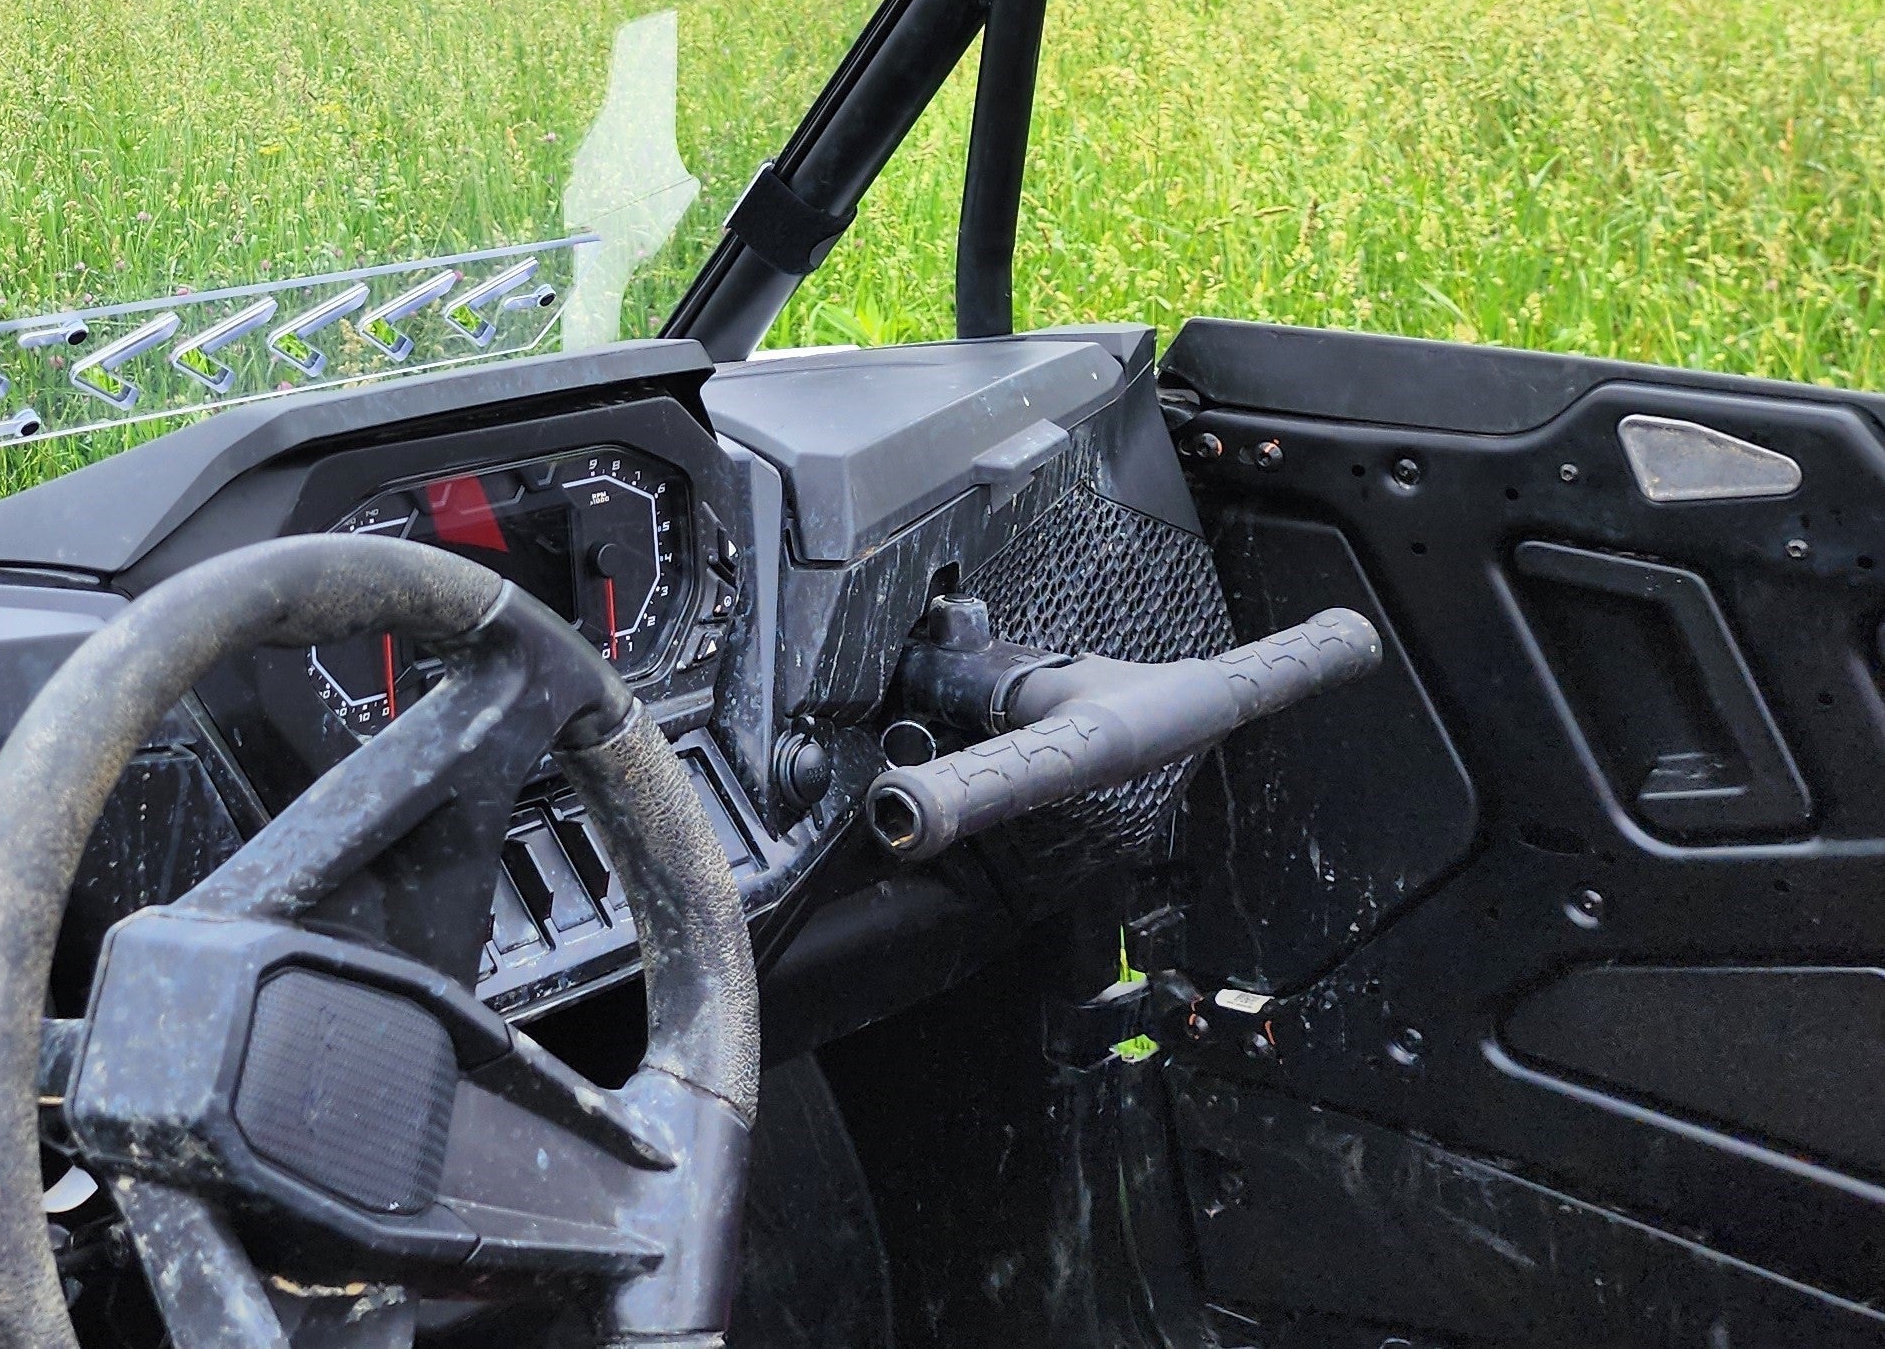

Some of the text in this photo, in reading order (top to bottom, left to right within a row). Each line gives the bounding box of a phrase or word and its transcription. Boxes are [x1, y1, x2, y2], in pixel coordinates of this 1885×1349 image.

[588, 459, 598, 470] 9
[612, 460, 621, 470] 8
[634, 471, 641, 480] 7
[657, 483, 666, 493] 6
[662, 521, 671, 531] 5
[664, 553, 673, 563] 4
[661, 586, 669, 596] 3
[647, 615, 657, 627] 2
[628, 642, 634, 652] 1
[602, 648, 610, 659] 0
[381, 707, 390, 717] 0
[358, 712, 371, 723] 10
